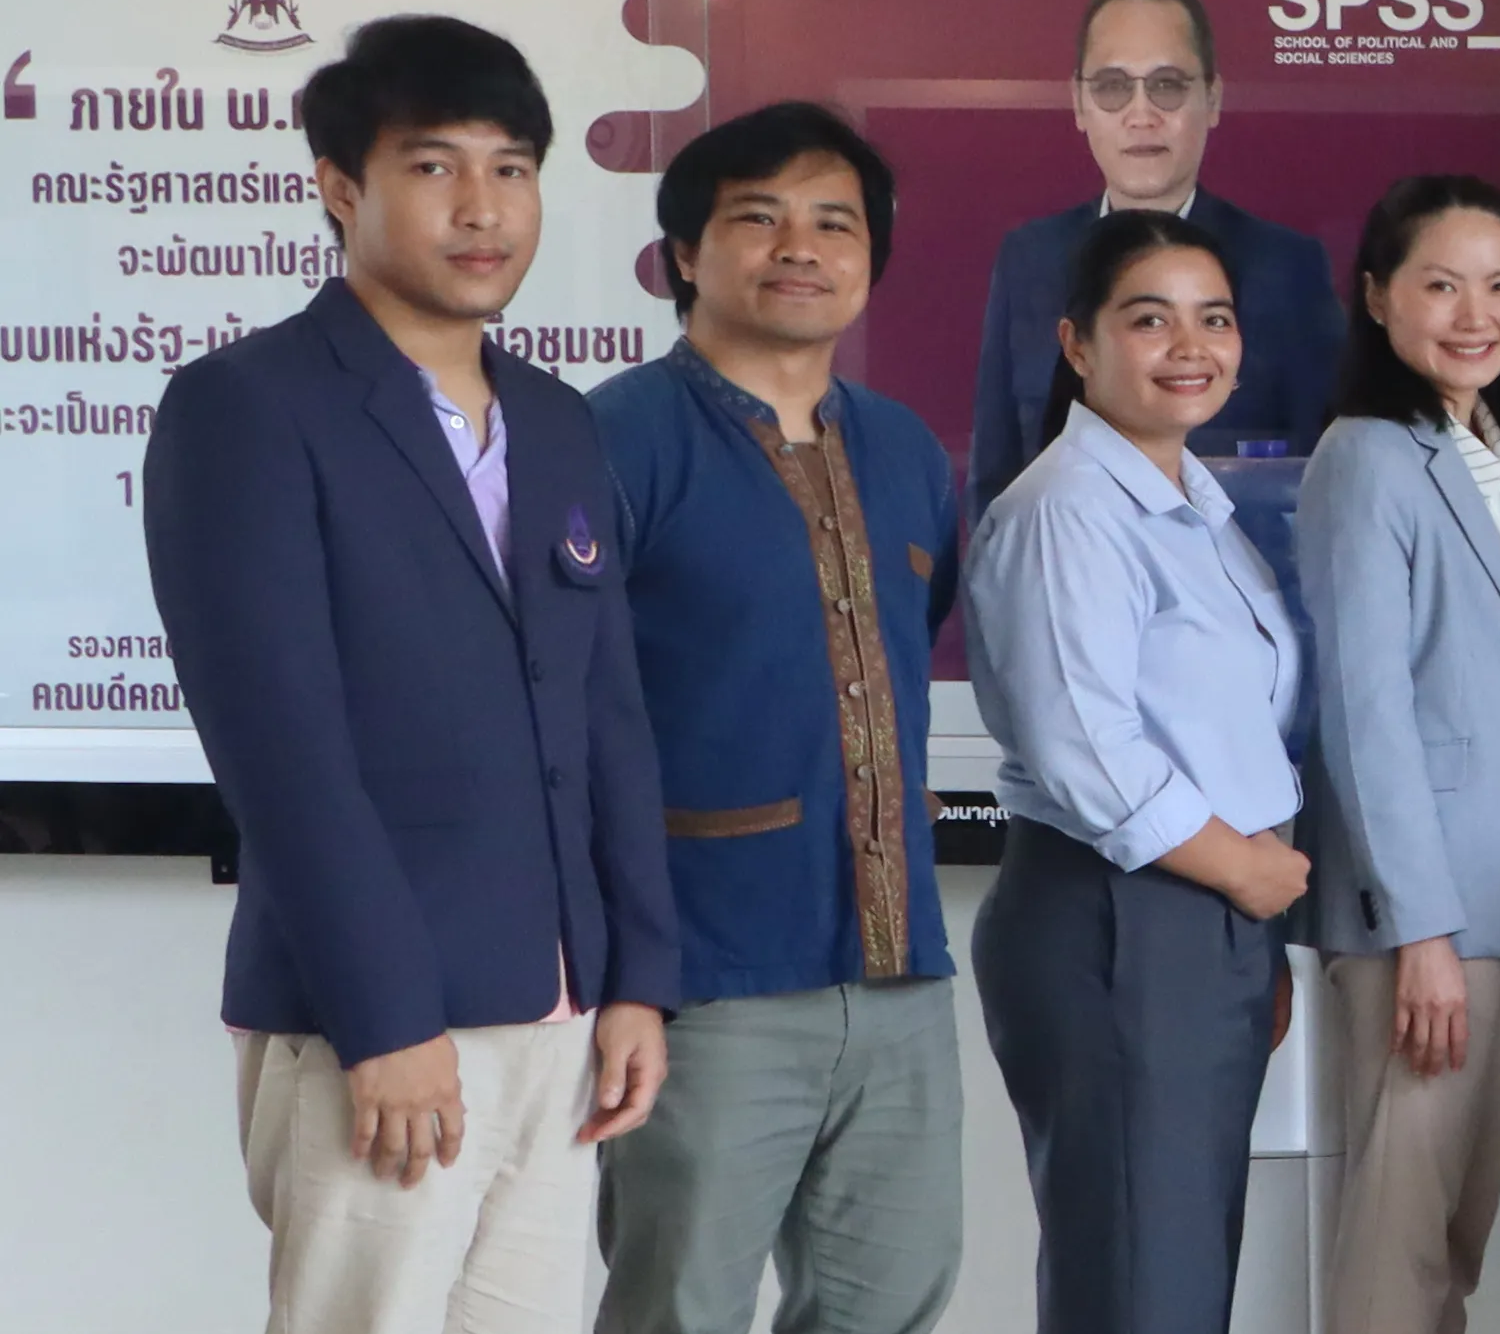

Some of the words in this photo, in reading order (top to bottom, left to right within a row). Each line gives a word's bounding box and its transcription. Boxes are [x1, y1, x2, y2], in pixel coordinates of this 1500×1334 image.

[1274, 36, 1330, 49] SCHOOL
[1334, 36, 1353, 49] OF
[1357, 36, 1425, 49] POLITICAL
[1429, 36, 1458, 49] AND
[1274, 52, 1323, 64] SOCIAL
[1328, 52, 1395, 64] SCIENCES
[70, 67, 204, 130] ภายใน
[227, 87, 304, 130] พ.
[33, 672, 187, 711] คณบดีคณ
